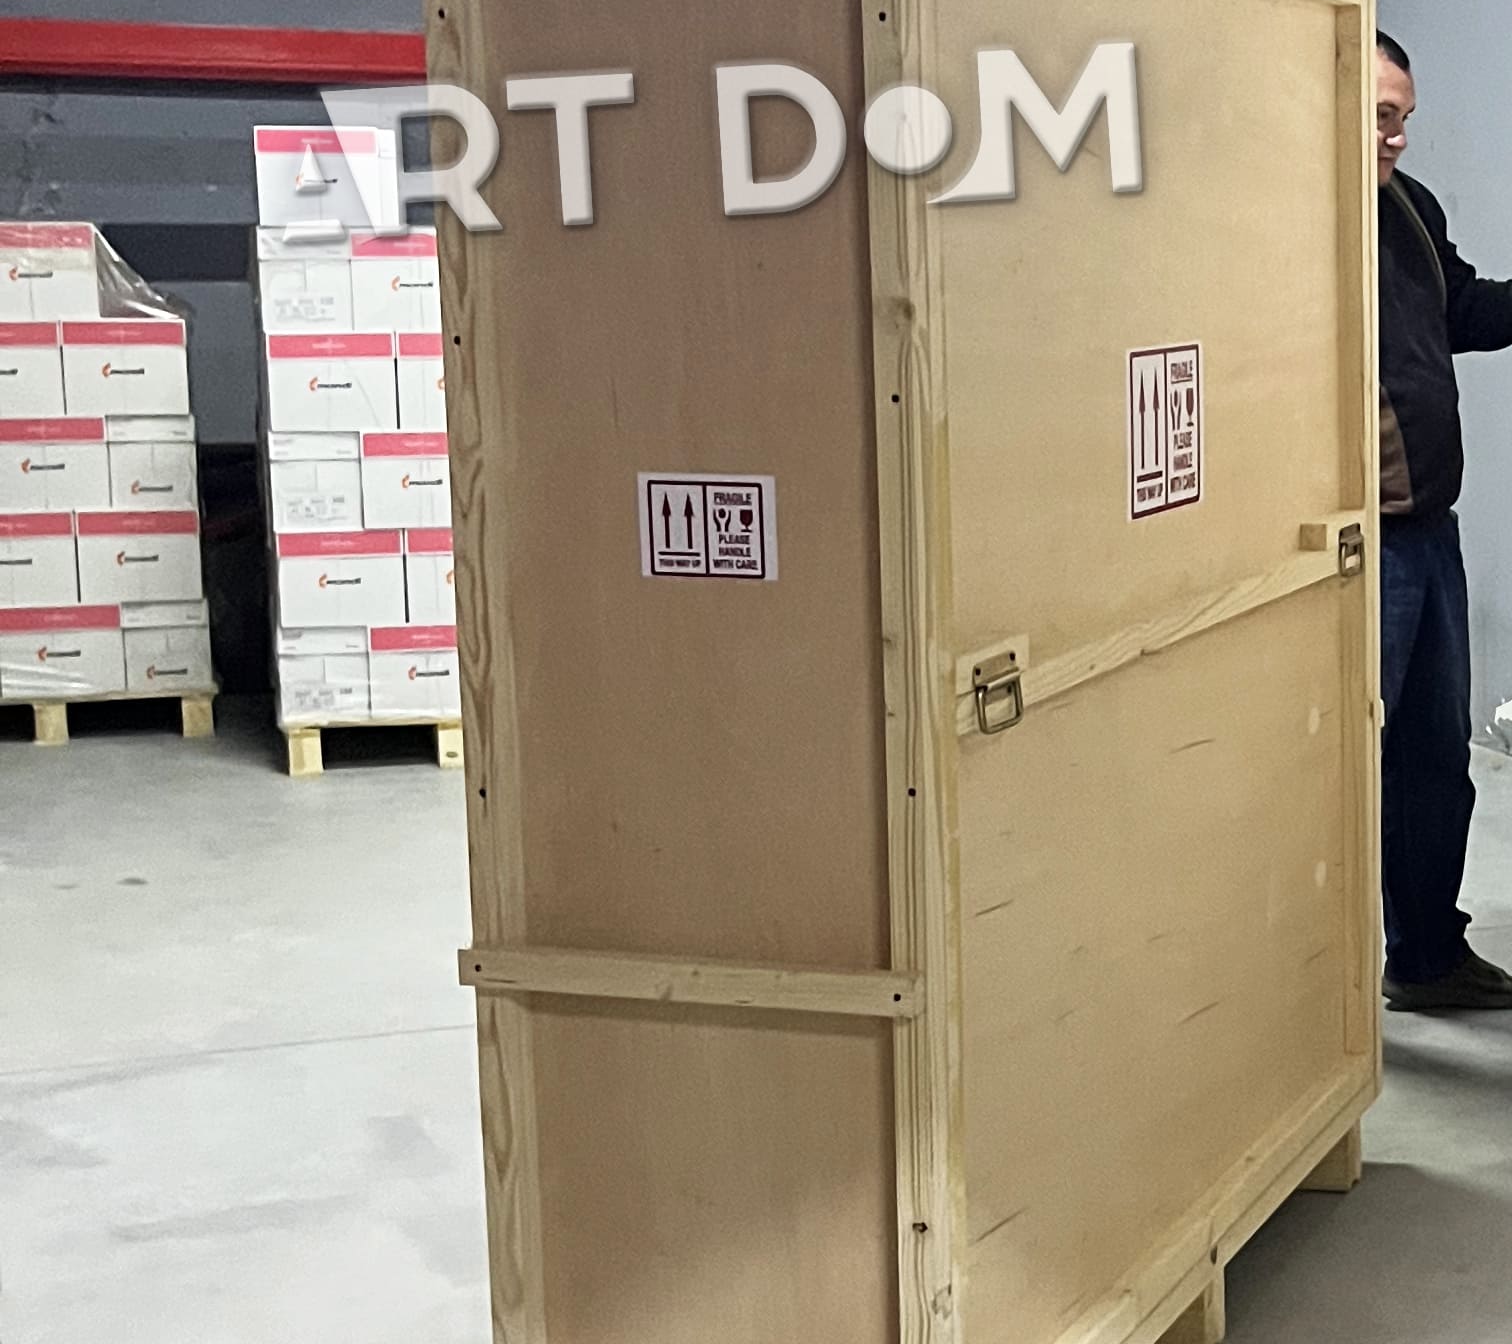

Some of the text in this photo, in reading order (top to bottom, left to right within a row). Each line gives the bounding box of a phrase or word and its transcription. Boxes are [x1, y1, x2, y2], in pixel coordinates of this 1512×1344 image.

[713, 492, 752, 506] FRAGILE
[718, 534, 750, 544] PLEASE
[718, 547, 751, 557] HANDLE
[713, 559, 758, 570] WITH CARE
